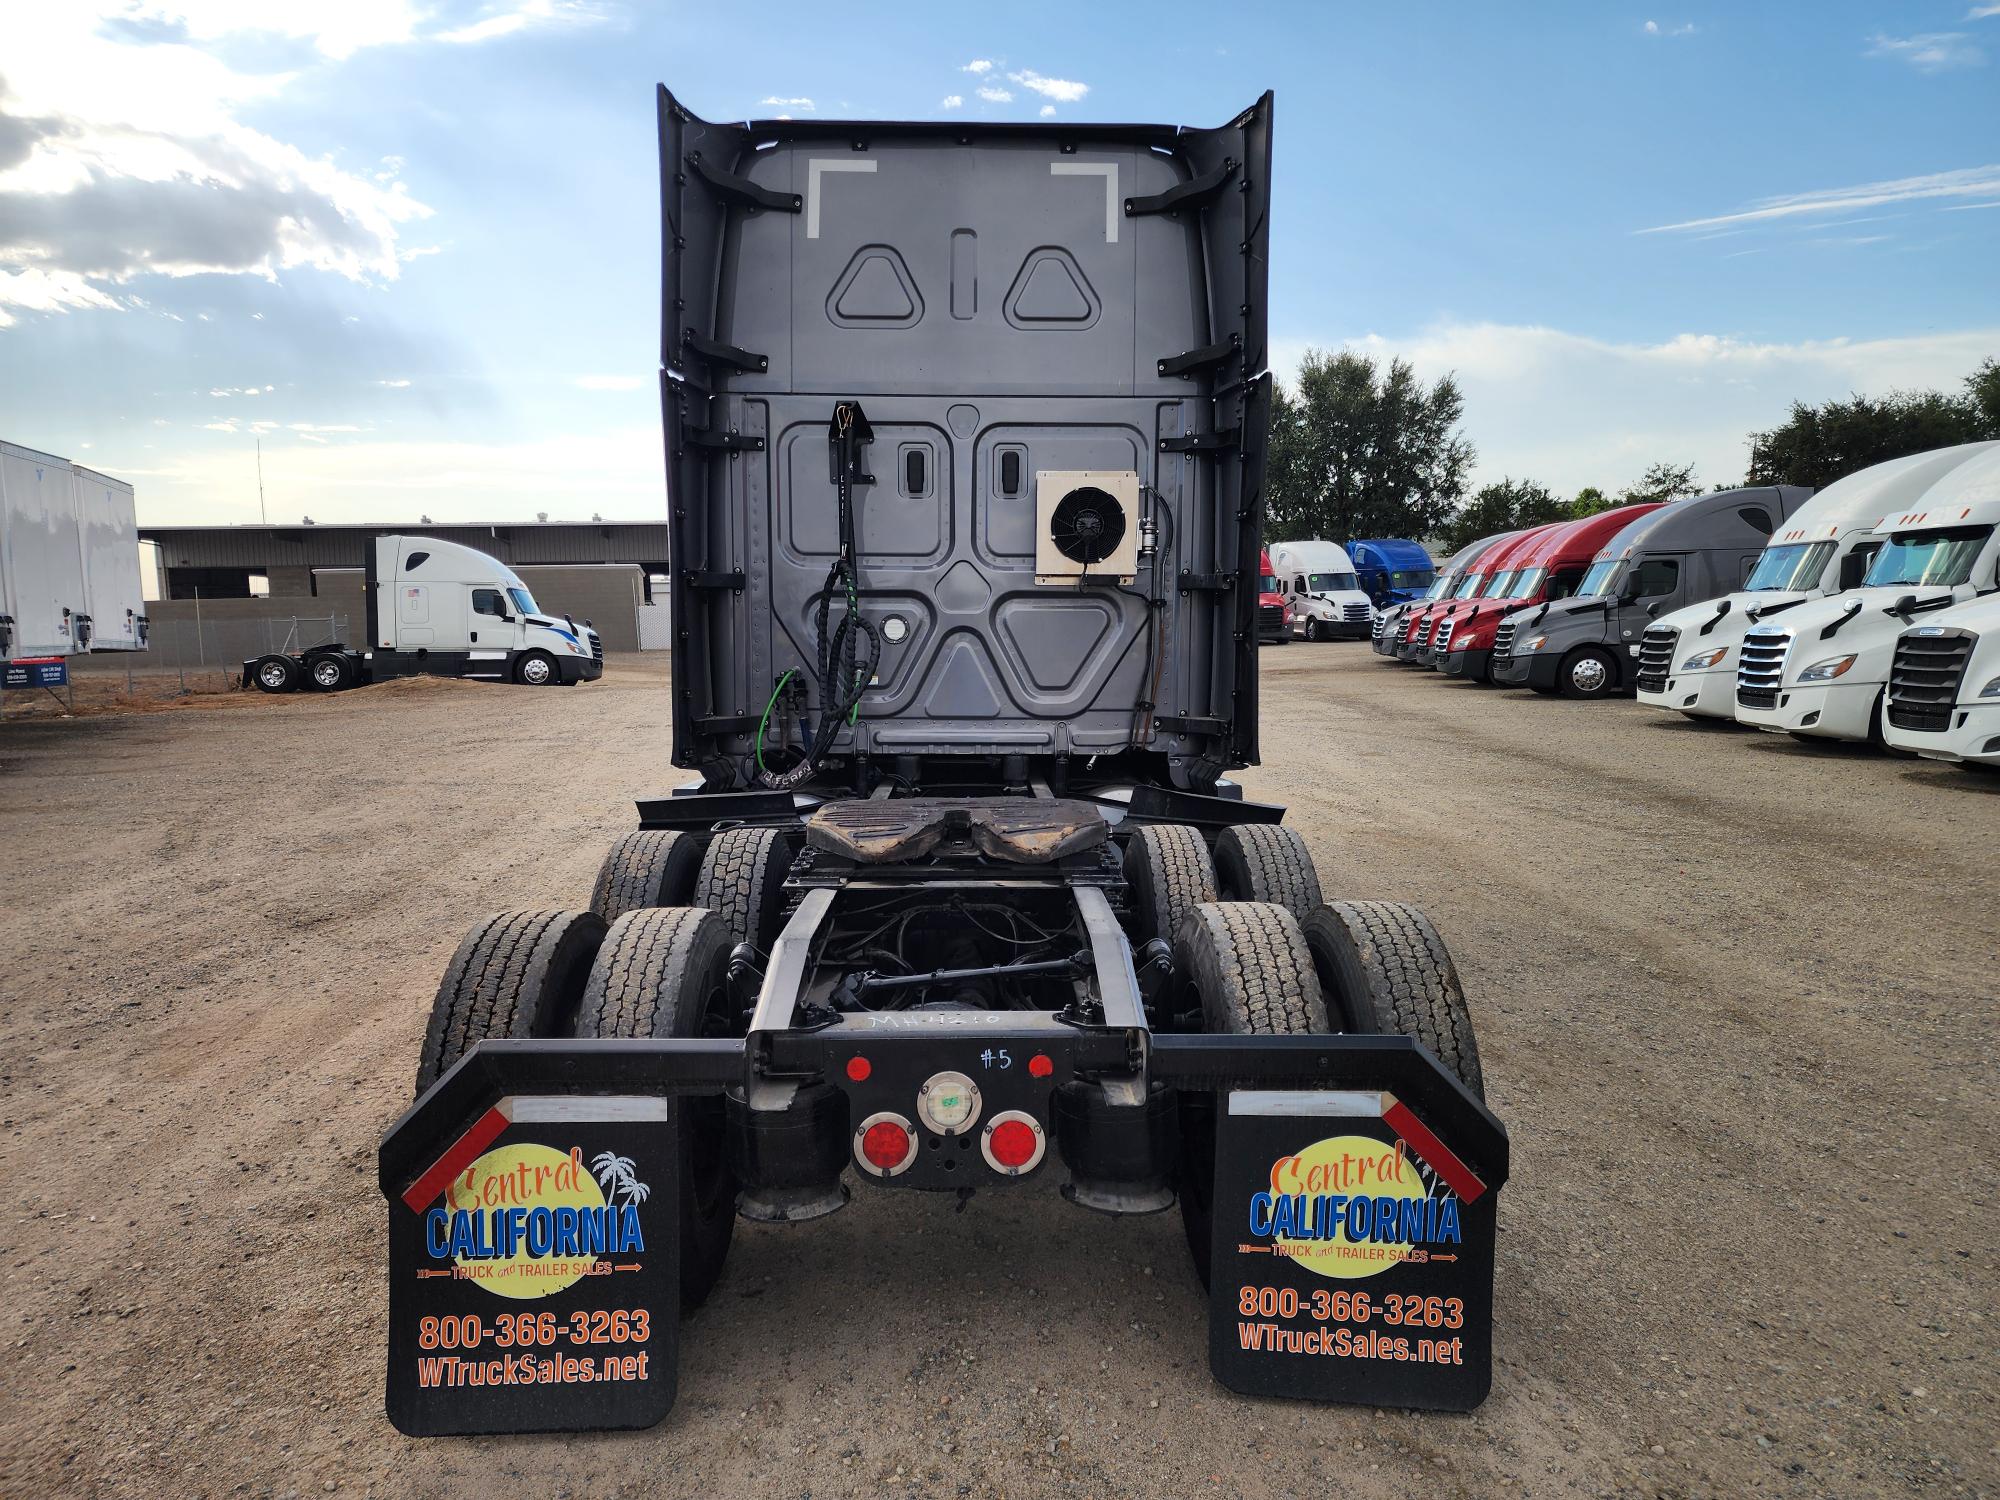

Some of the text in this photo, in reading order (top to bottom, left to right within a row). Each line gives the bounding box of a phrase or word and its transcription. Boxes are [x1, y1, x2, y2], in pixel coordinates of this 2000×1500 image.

[980, 1048, 1012, 1070] #5
[445, 1146, 584, 1213] Central
[1270, 1138, 1407, 1198] Central
[426, 1204, 645, 1260] CALIFORNIA
[1250, 1191, 1462, 1245] CALIFORNIA
[451, 1261, 613, 1280] TRUCK and TRAILER SALES
[1272, 1244, 1429, 1264] TRUCK and TRAILER SALES
[1238, 1286, 1464, 1329] 800-366-3263
[418, 1309, 650, 1350] 800-366-3263
[1238, 1322, 1463, 1365] WTruckSales.net
[417, 1351, 649, 1388] WTruckSales.net
